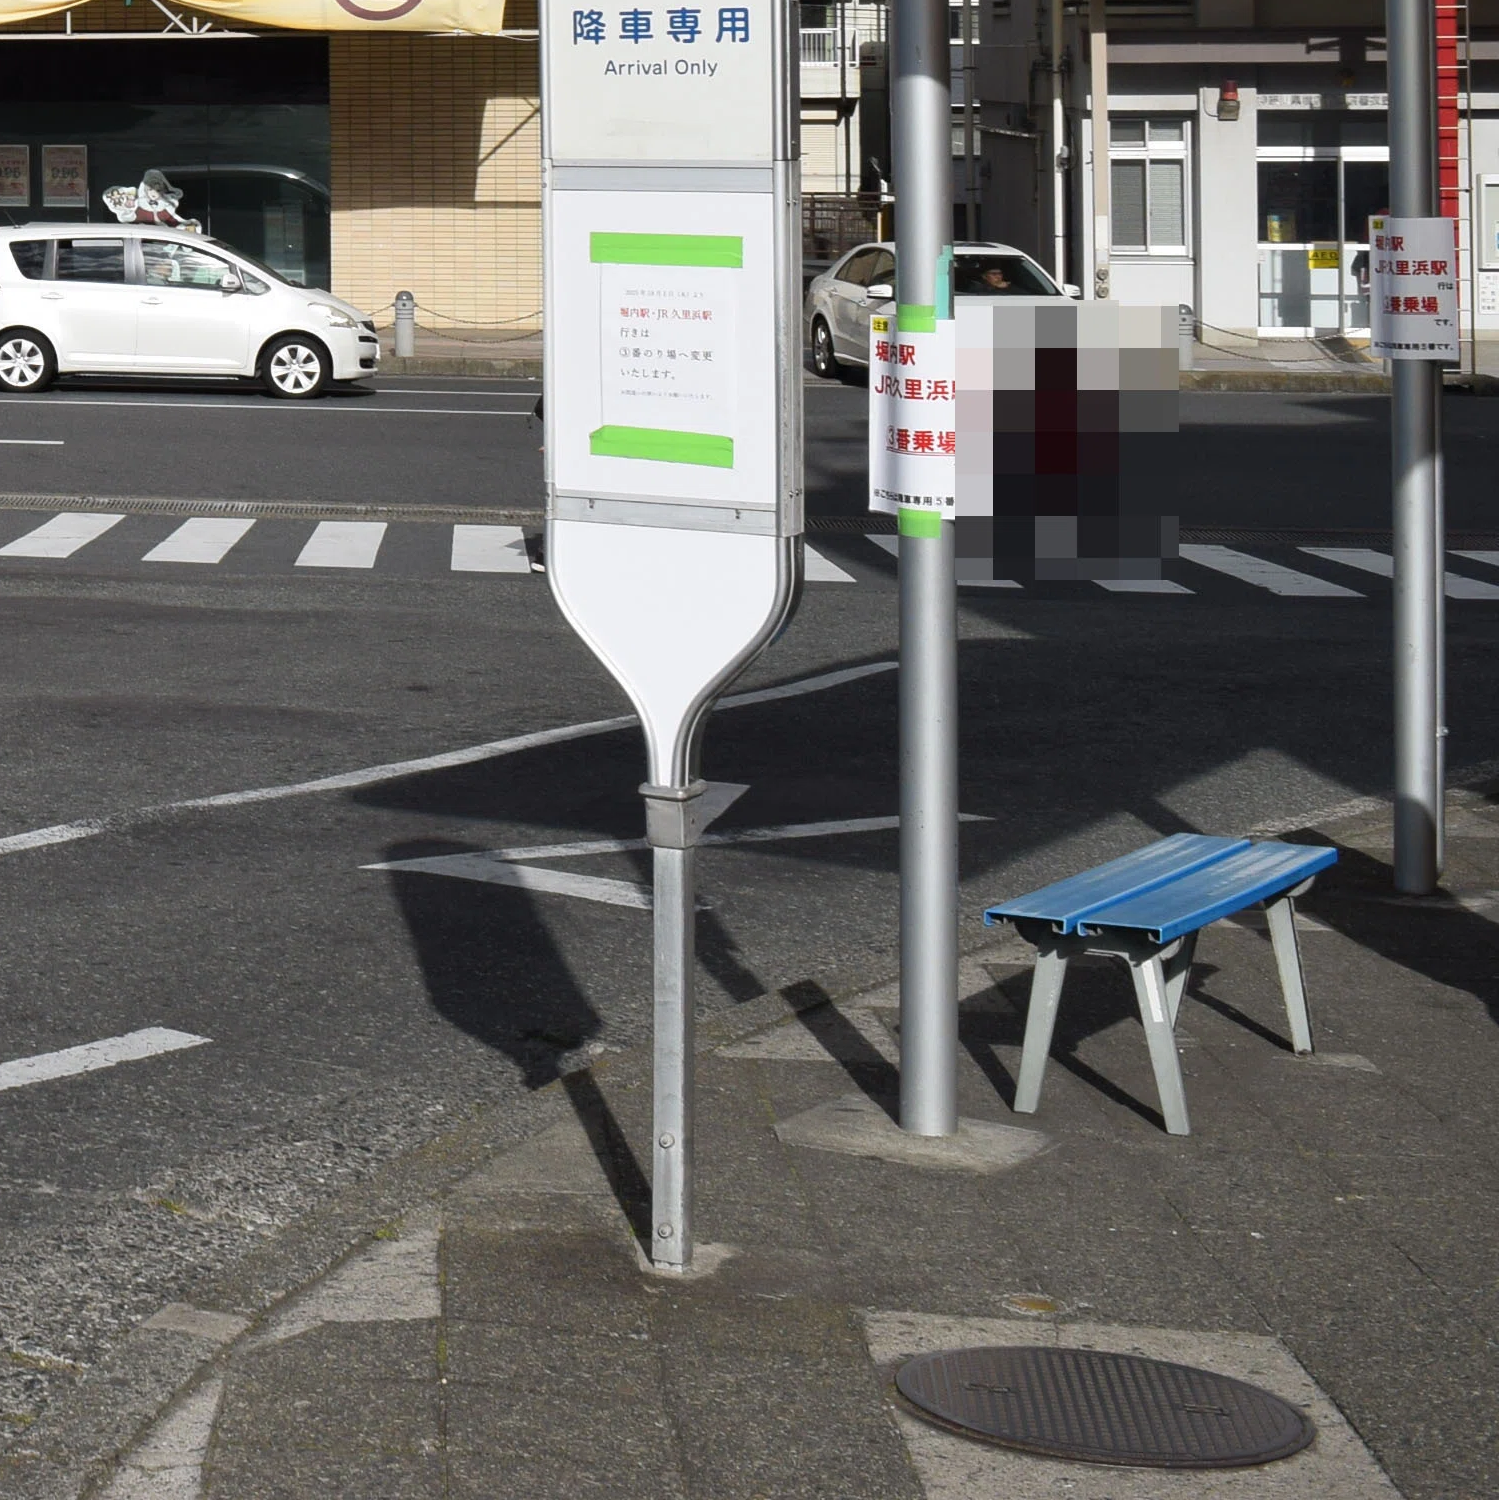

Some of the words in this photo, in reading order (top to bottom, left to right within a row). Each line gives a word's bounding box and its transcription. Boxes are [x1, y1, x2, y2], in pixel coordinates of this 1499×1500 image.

[572, 7, 751, 46] 降車専用
[604, 60, 668, 76] Arrival
[674, 59, 718, 77] Only
[875, 375, 956, 401] JR久里浜
